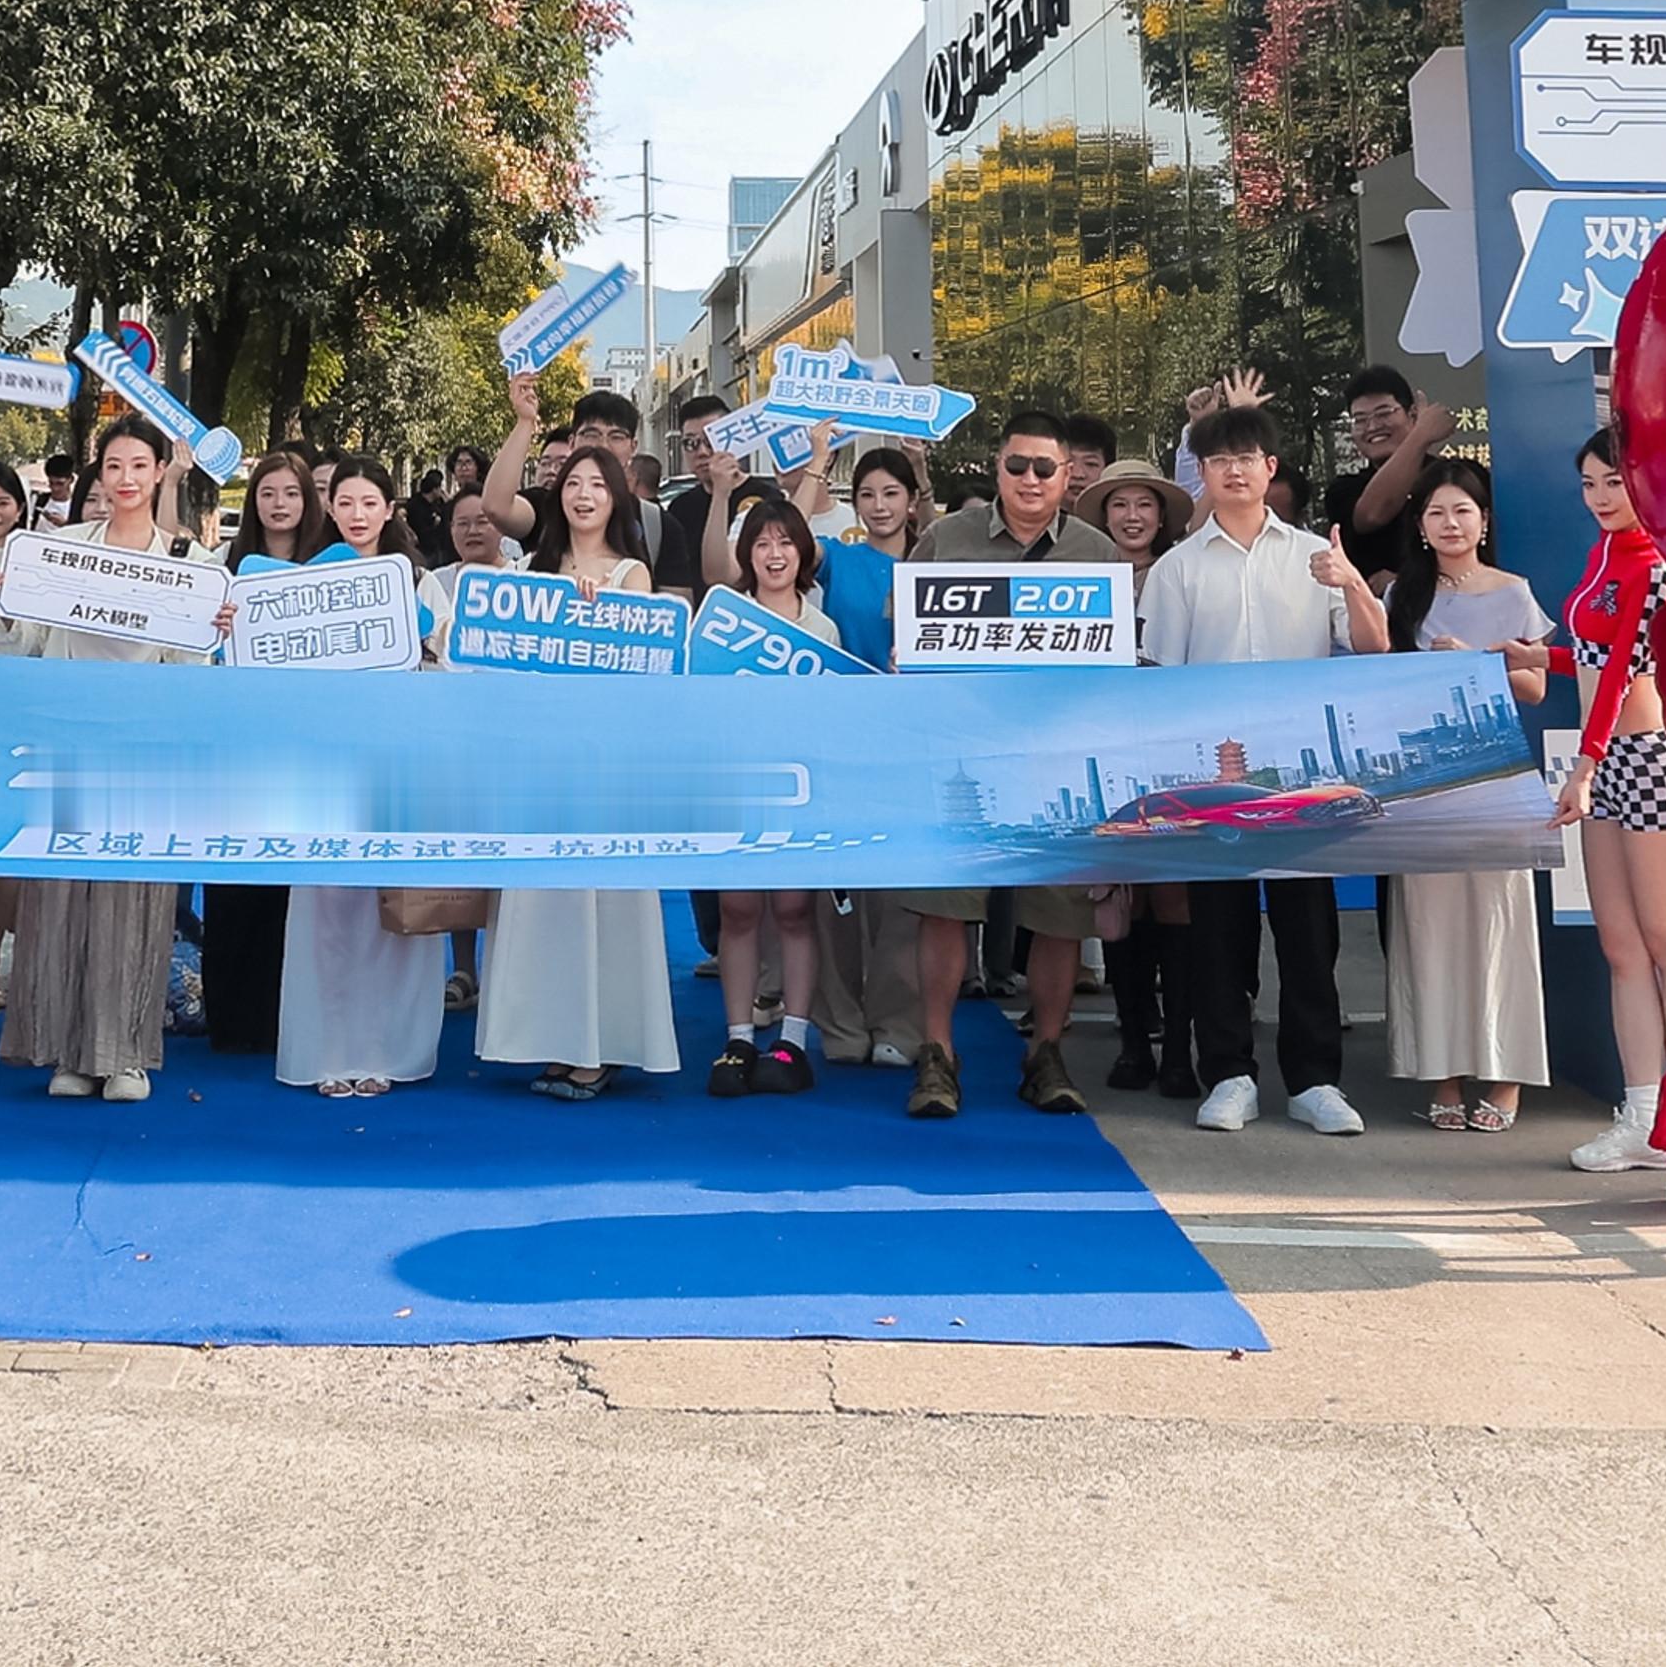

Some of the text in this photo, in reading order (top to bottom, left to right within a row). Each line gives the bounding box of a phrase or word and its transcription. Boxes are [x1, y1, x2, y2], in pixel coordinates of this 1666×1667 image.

[774, 379, 933, 414] 超大视野全景天窗
[716, 413, 785, 451] 天生
[41, 547, 194, 589] 车规级8255芯片
[69, 603, 149, 631] AI大模型
[247, 573, 391, 623] 六种控制
[1014, 584, 1100, 613] 2.0T
[251, 617, 396, 664] 电动尾门
[458, 625, 675, 674] 遗忘手机自动提醒
[914, 621, 1114, 653] 高功率发动机
